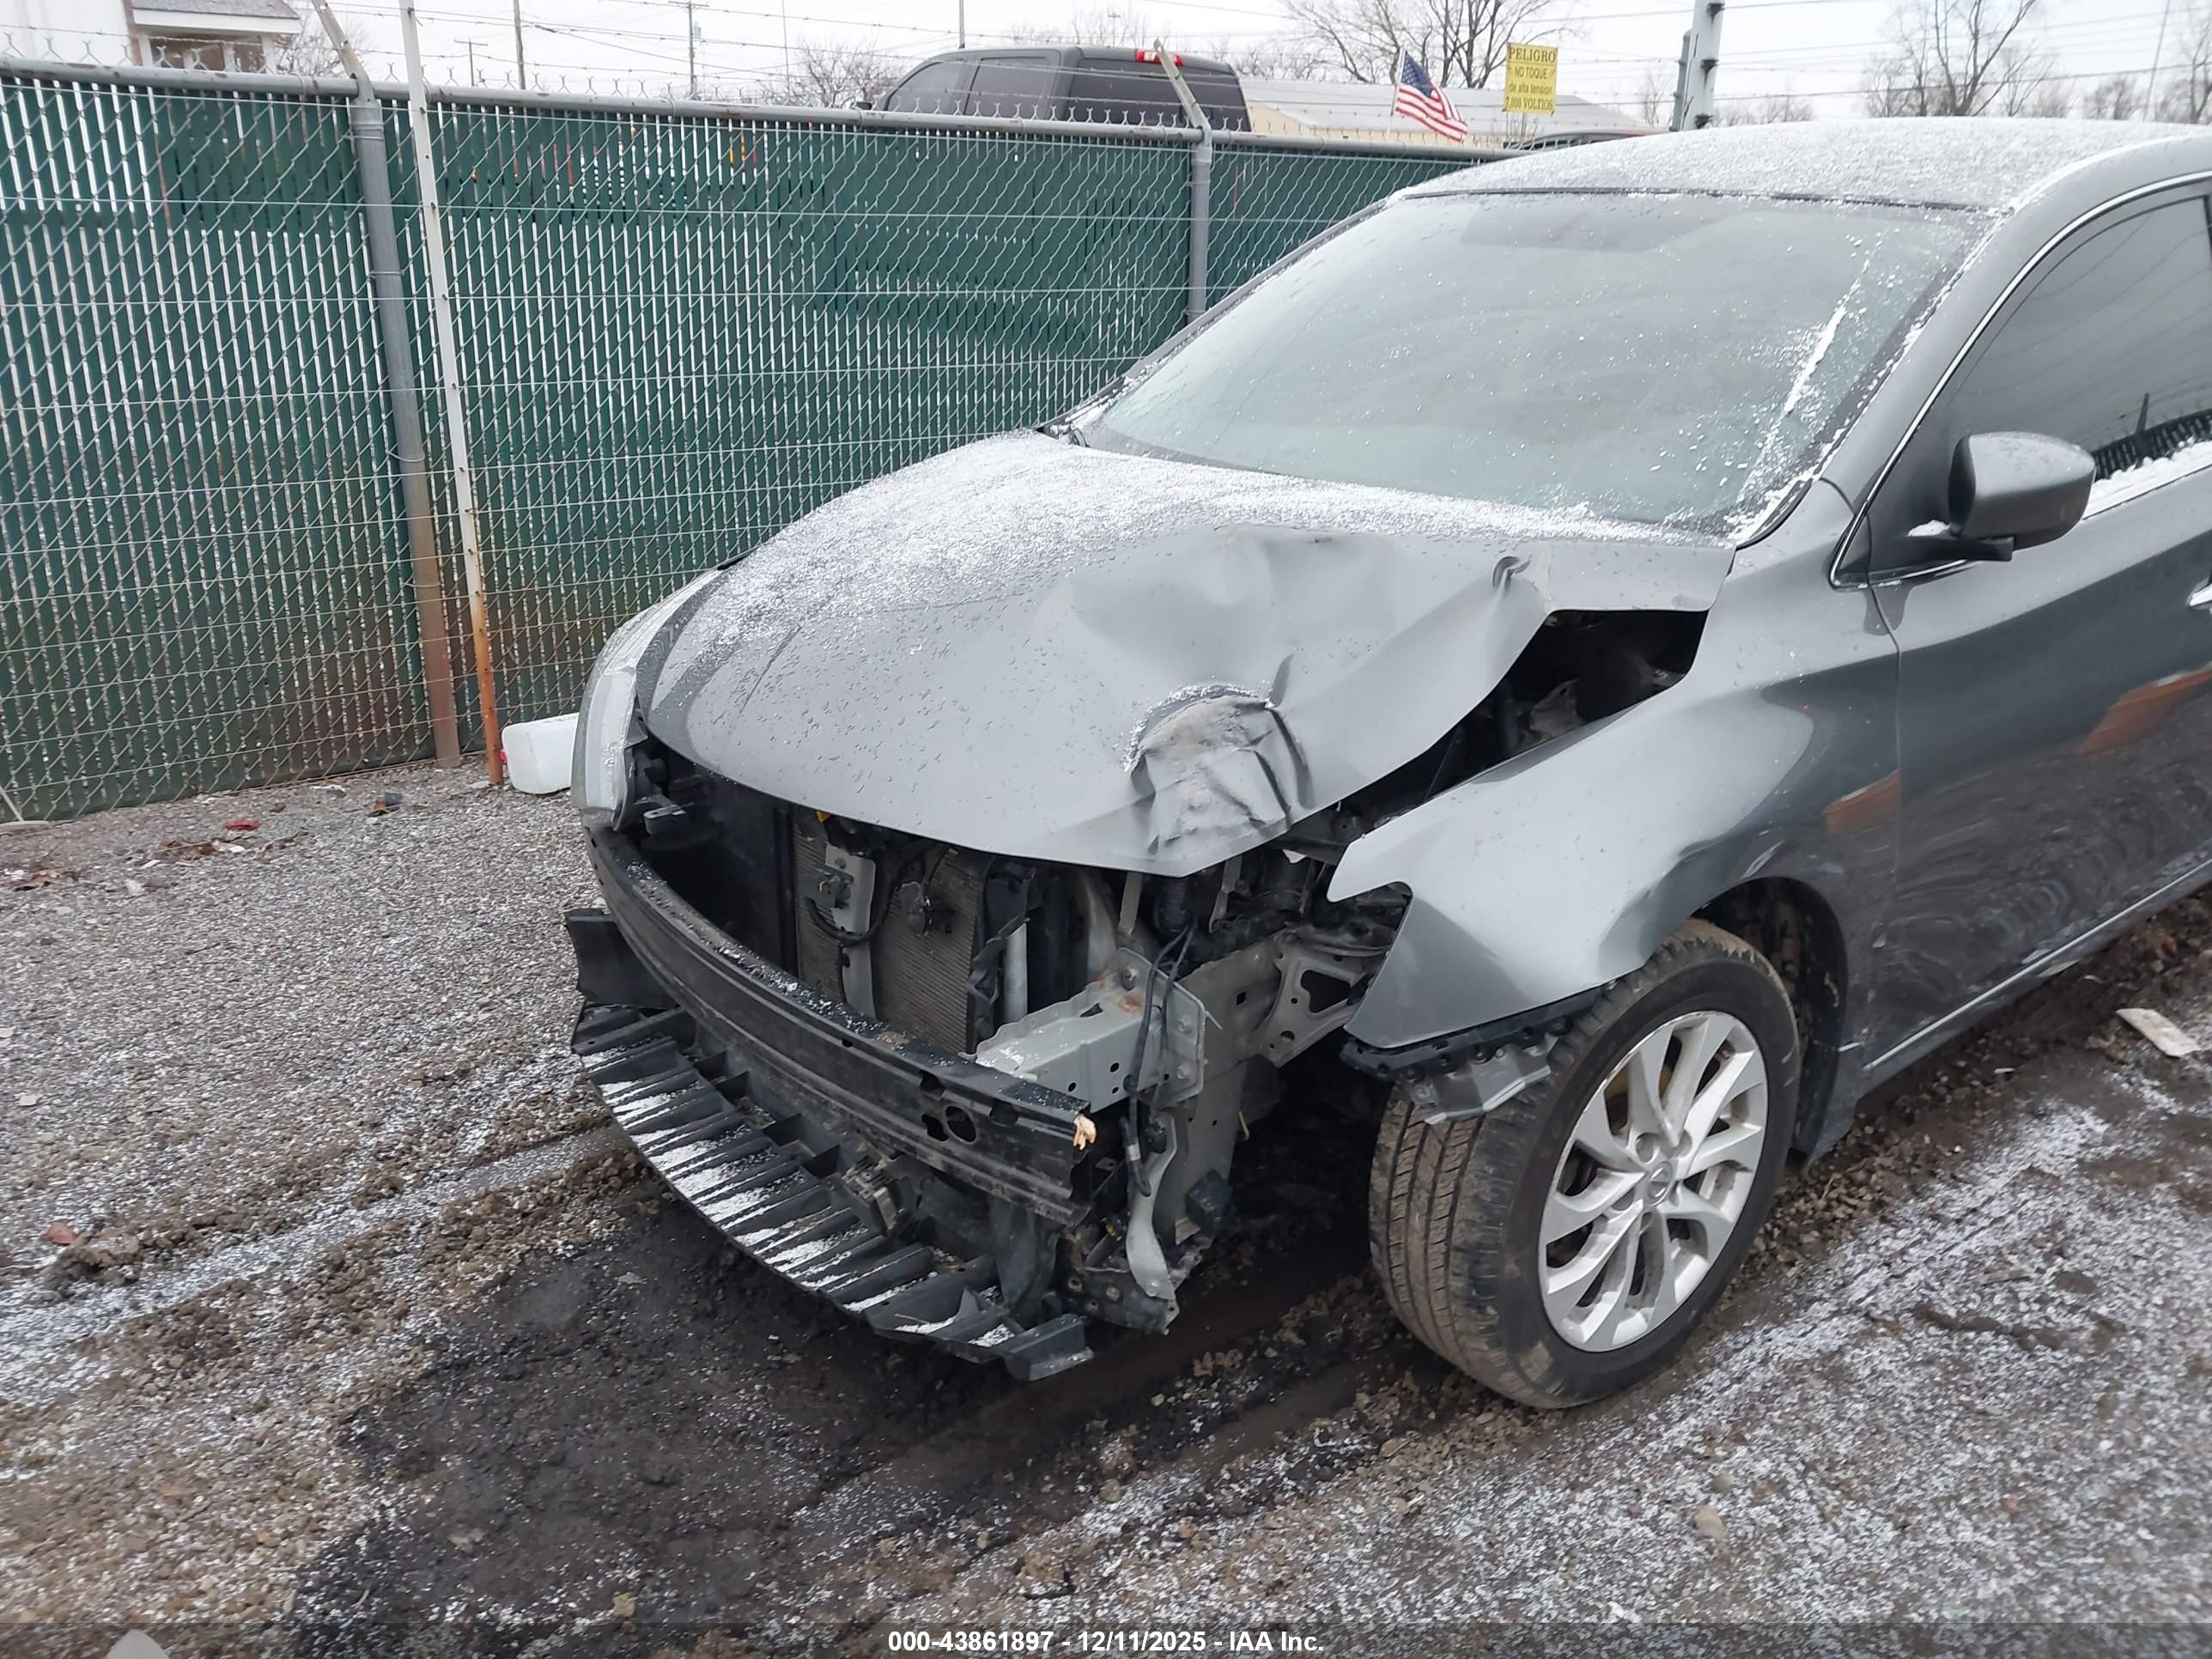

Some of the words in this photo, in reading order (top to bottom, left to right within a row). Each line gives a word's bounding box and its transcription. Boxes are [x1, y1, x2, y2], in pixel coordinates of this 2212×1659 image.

[1508, 47, 1556, 63] PELIGRO
[1515, 66, 1524, 77] NO
[1526, 67, 1547, 79] TOQUE
[1509, 82, 1516, 93] de
[1518, 83, 1529, 93] alta
[1523, 97, 1553, 111] VOLTIOS
